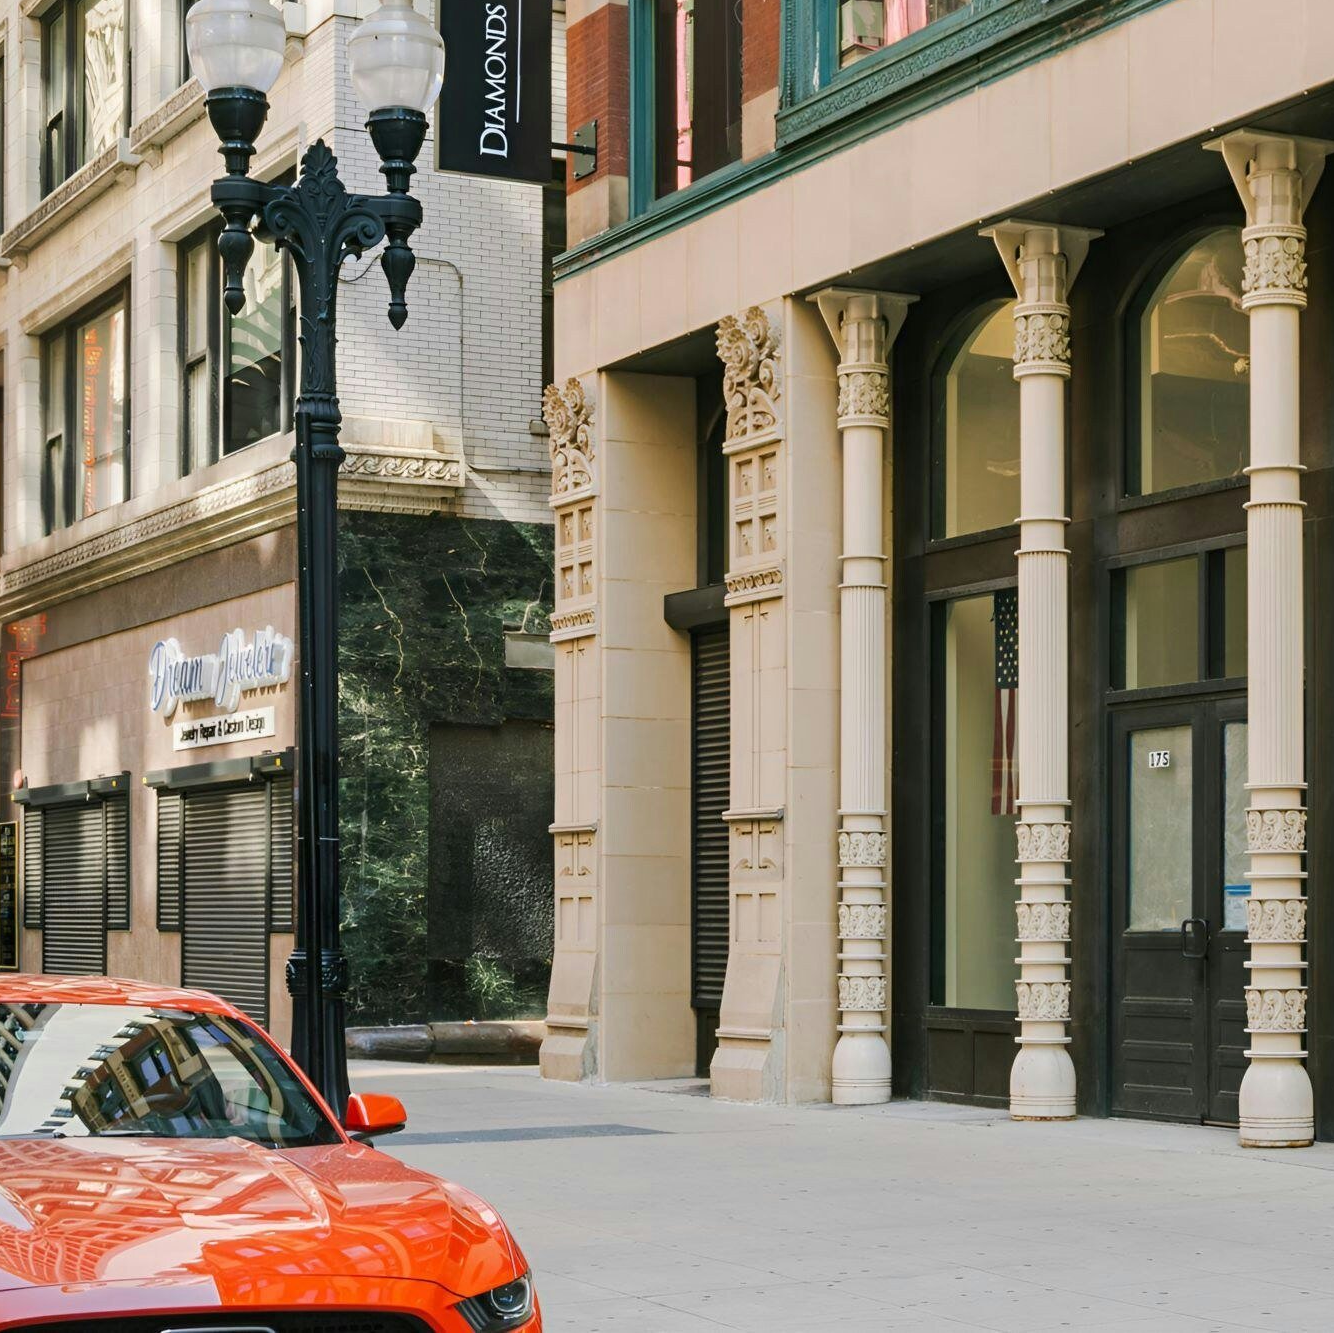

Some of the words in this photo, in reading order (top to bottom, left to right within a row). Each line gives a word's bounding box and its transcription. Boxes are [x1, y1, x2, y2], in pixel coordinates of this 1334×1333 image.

[479, 2, 509, 158] DIAMONDS
[150, 638, 216, 713] Dream
[1149, 751, 1169, 767] 175
